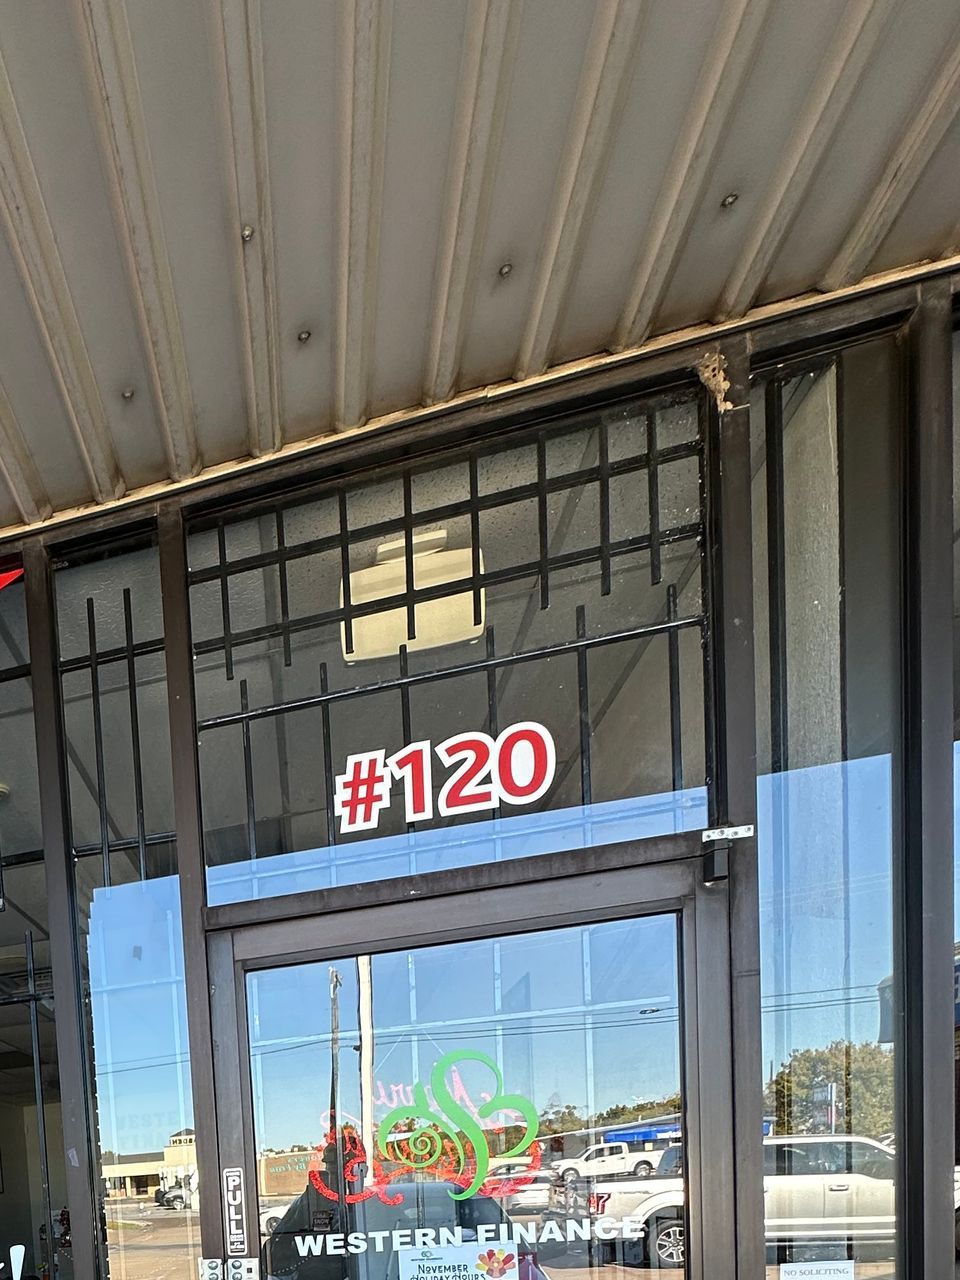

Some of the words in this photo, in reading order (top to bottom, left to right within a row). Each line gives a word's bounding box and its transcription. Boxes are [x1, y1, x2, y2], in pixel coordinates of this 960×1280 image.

[334, 721, 556, 834] #120
[227, 1176, 243, 1235] PULL
[294, 1225, 465, 1257] WESTERN
[476, 1215, 645, 1246] FINANCE
[800, 1268, 849, 1276] SOLICITING
